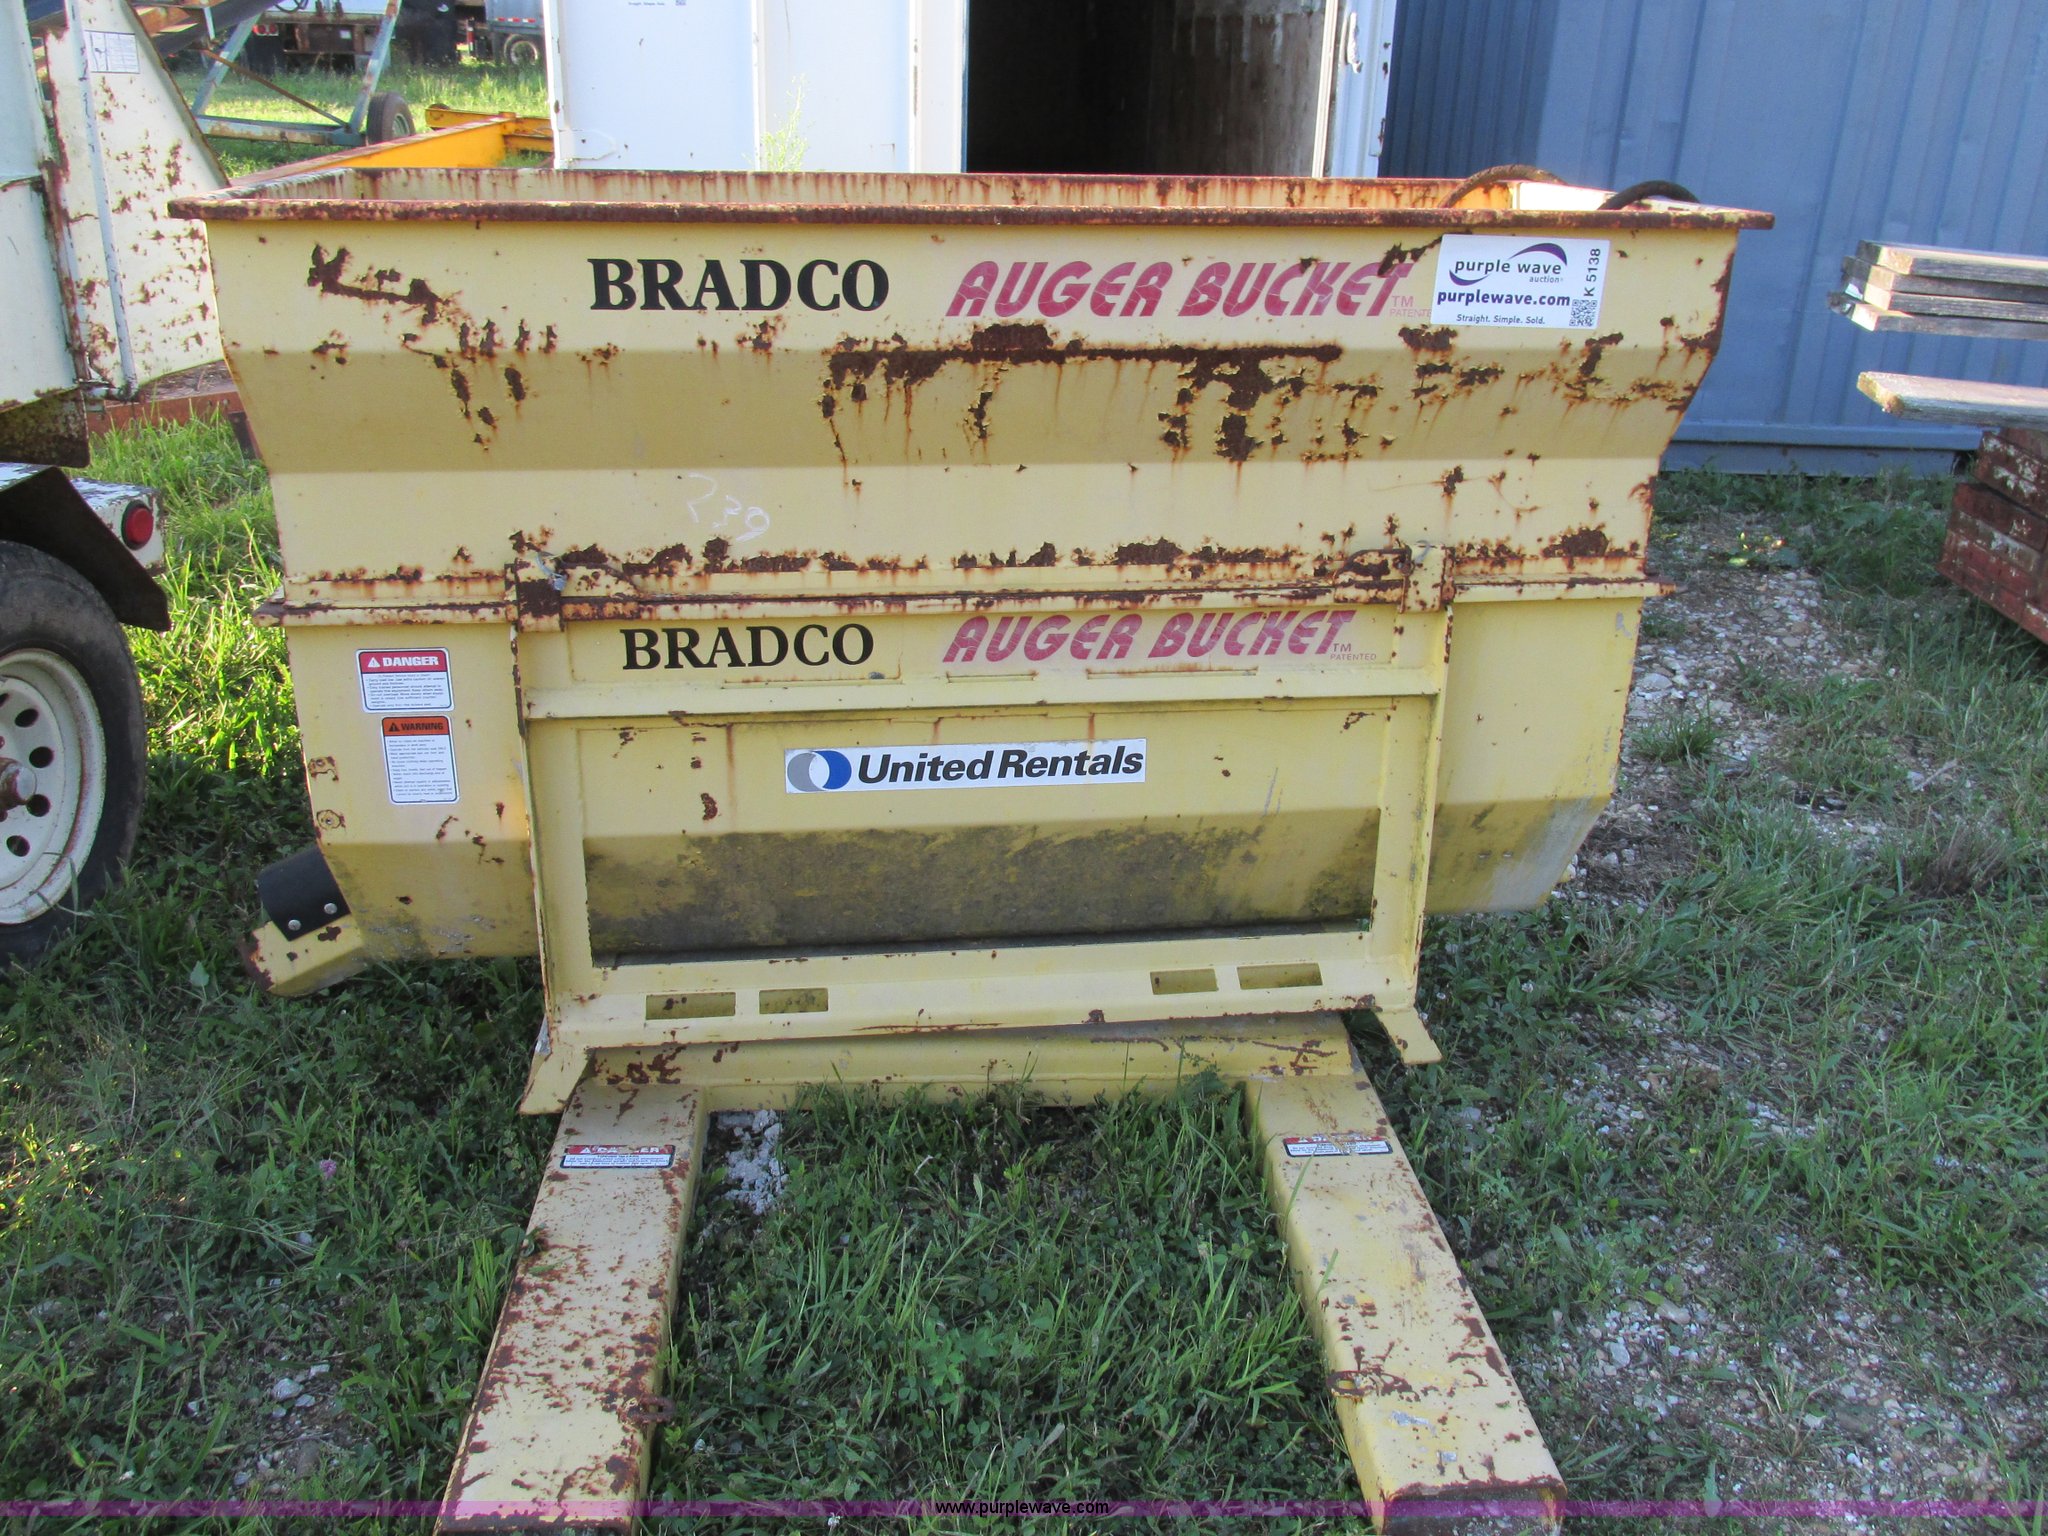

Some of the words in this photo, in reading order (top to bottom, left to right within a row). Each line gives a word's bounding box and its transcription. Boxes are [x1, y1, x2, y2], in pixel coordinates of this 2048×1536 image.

[1454, 259, 1511, 275] purple
[1517, 263, 1562, 275] wave
[1586, 248, 1601, 283] 5138
[587, 258, 889, 311] BRADCO
[945, 260, 1173, 317] AUGER
[1178, 261, 1416, 317] BUCKET
[1437, 289, 1571, 307] purplewave.com
[1390, 309, 1431, 318] PATENTE
[1456, 313, 1491, 324] Straight.
[1493, 314, 1523, 324] Simple.
[1525, 315, 1546, 325] Sold.
[942, 613, 1143, 663] AUGER
[1147, 609, 1357, 659] BUCKET
[619, 623, 874, 670] BRADCO
[1333, 643, 1352, 653] TM
[382, 656, 439, 667] DANGER
[1329, 652, 1377, 661] PATENTED
[400, 722, 444, 731] WARNING
[858, 751, 994, 784] United
[997, 746, 1144, 779] Rentals
